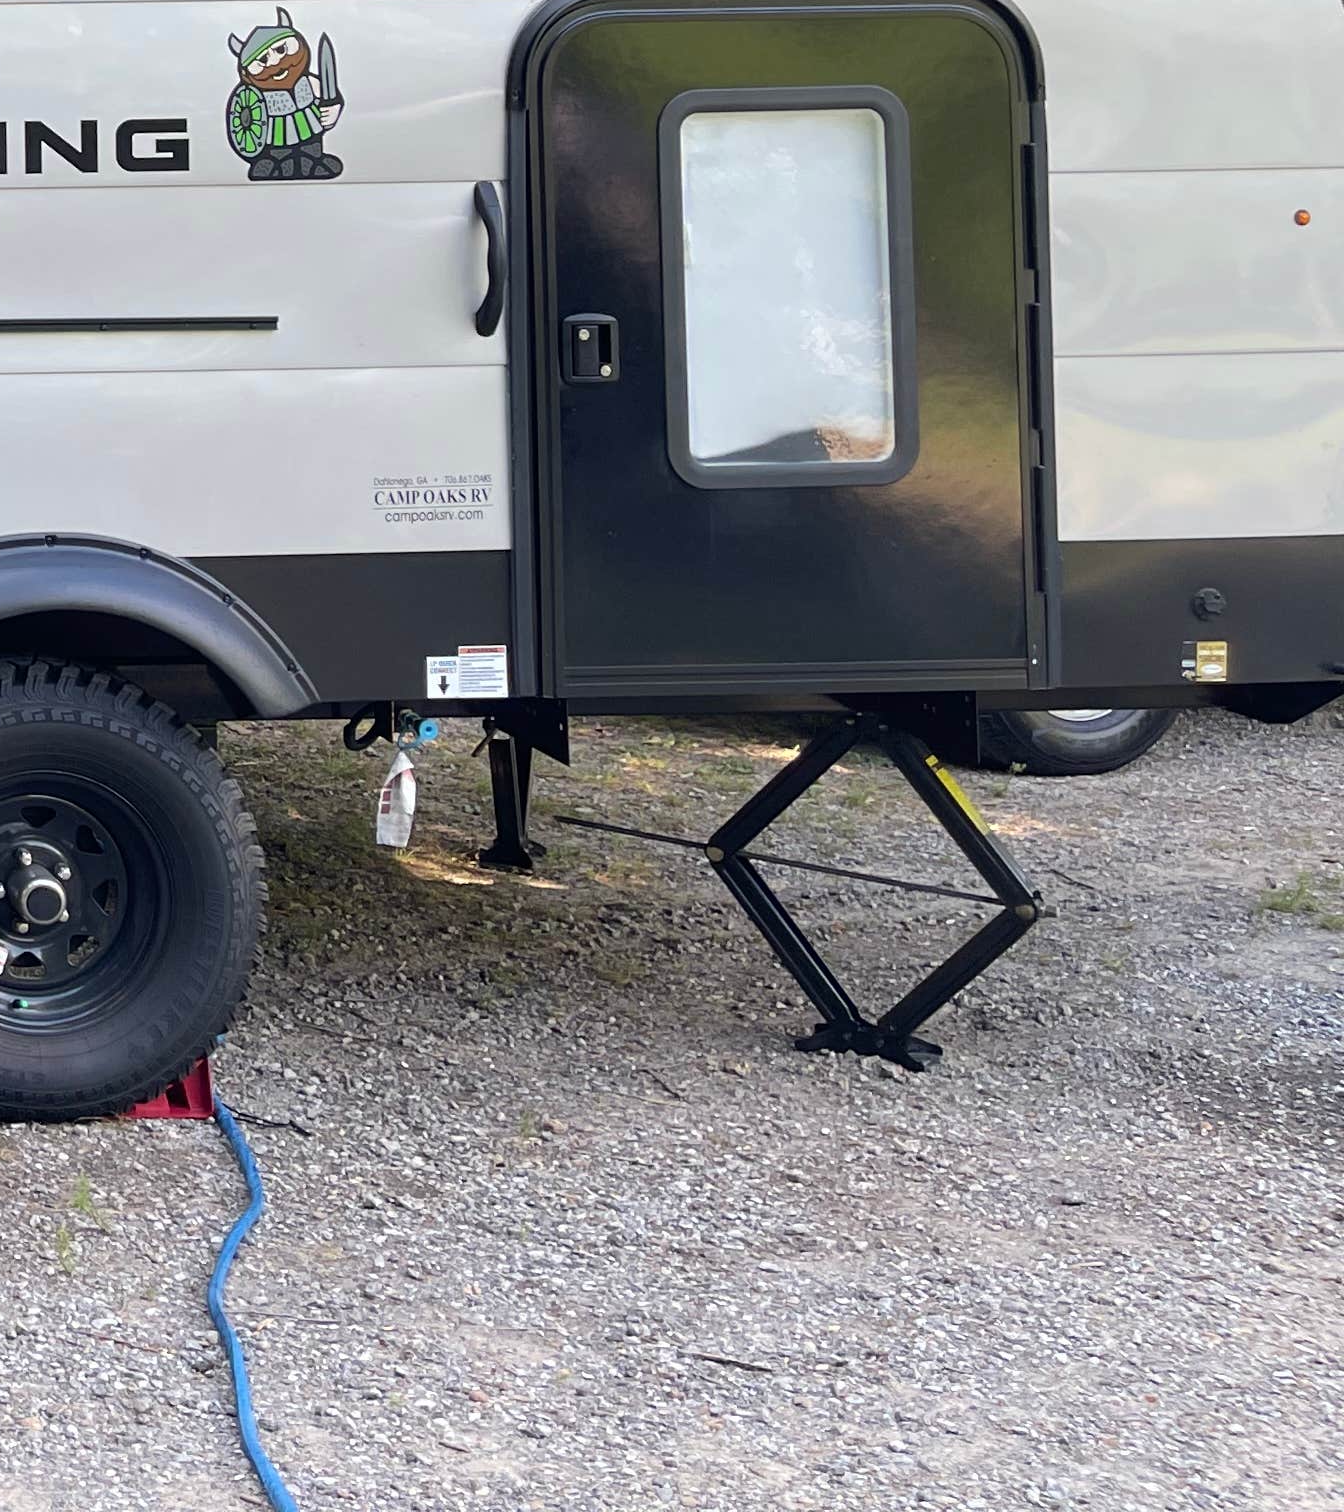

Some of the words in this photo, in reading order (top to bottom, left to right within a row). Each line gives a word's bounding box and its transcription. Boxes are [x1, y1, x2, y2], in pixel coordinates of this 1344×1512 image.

[374, 490, 420, 505] CAMP
[423, 489, 467, 504] OAKS
[471, 488, 492, 503] RV
[384, 509, 484, 523] campoaksrv.com
